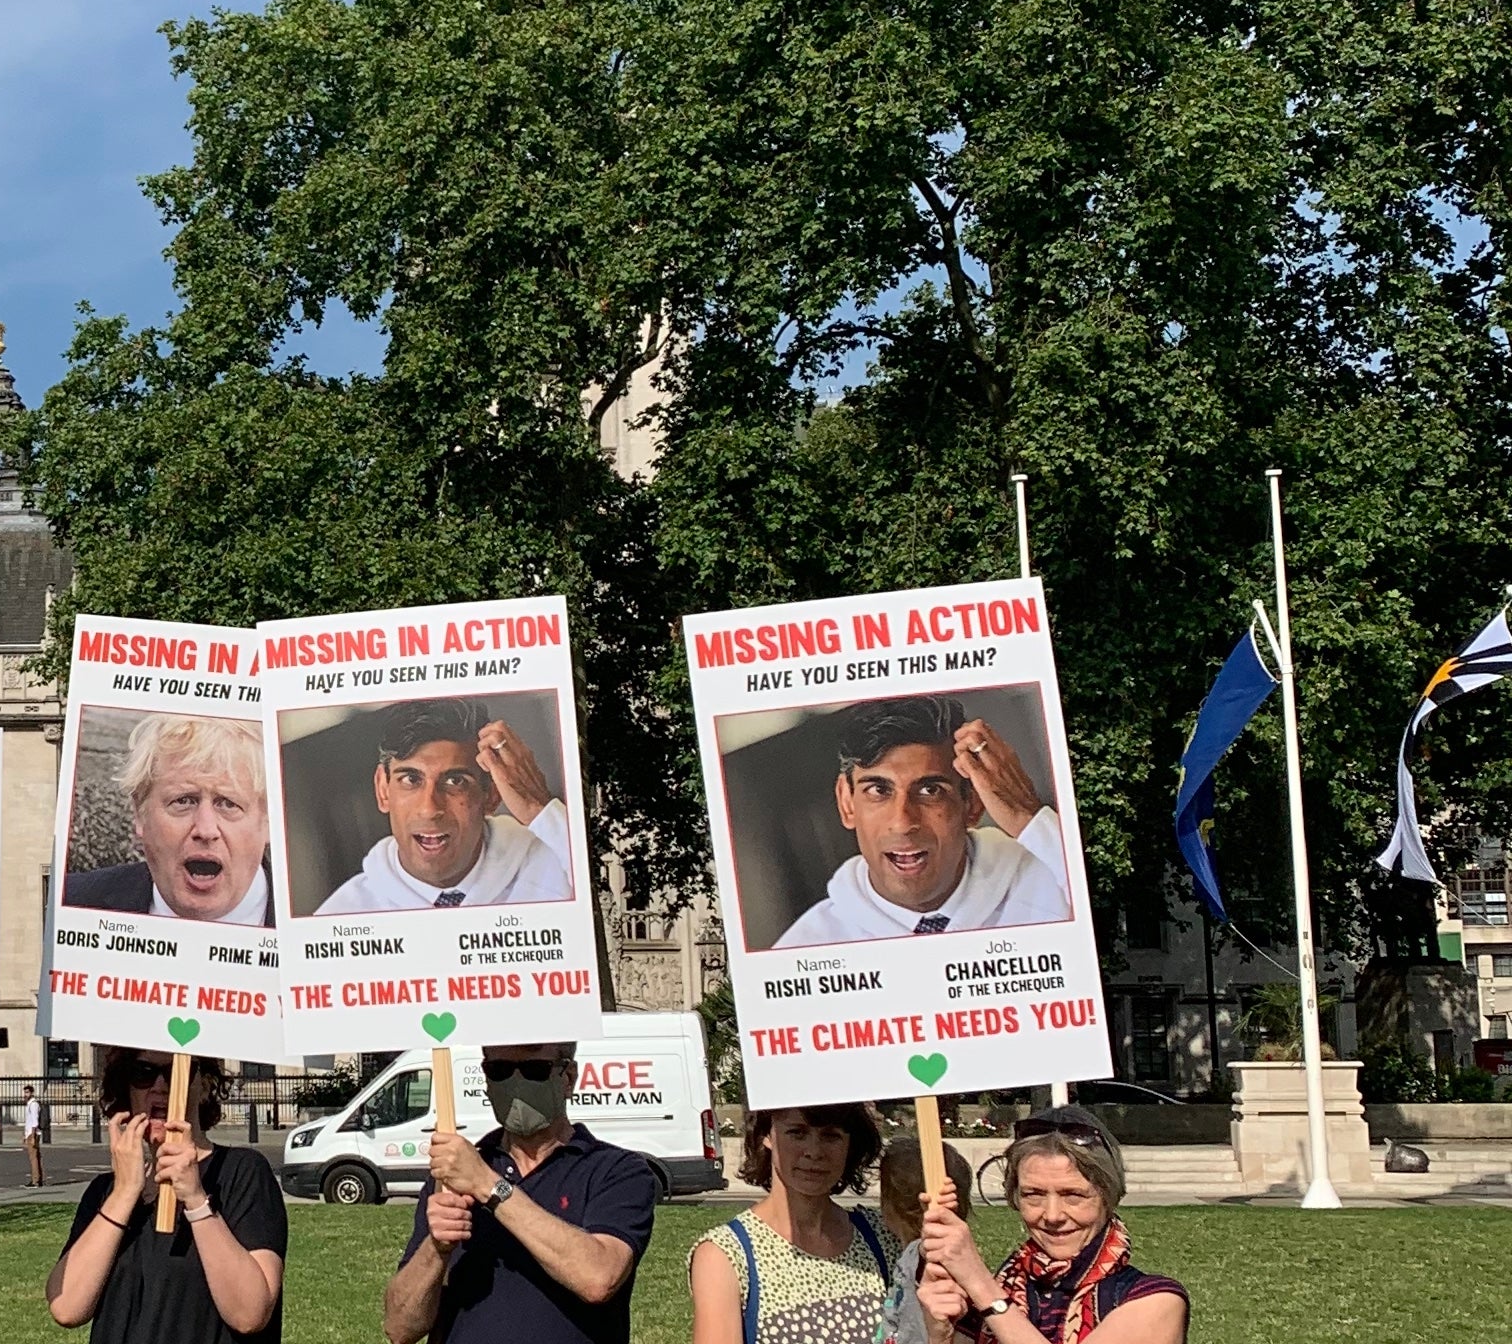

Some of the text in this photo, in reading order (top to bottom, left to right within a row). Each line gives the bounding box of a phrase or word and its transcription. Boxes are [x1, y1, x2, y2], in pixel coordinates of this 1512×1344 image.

[265, 628, 388, 670] MISSING
[398, 624, 430, 657] IN
[443, 614, 561, 654] ACTION
[694, 597, 1041, 669] MISSING IN ACTION
[78, 630, 198, 671] MISSING
[207, 642, 239, 675] IN
[305, 656, 522, 691] HAVE YOU SEEN THIS MAN?
[746, 646, 997, 693] HAVE YOU SEEN THIS MAN?
[112, 673, 262, 703] HAVE YOU SEEN THI
[98, 918, 139, 934] Name:
[332, 924, 375, 938] Name:
[494, 914, 523, 928] Job:
[56, 928, 178, 958] BORIS JOHNSON
[304, 937, 405, 960] RISHI SUNAK
[458, 928, 563, 951] CHANCELLOR
[985, 939, 1018, 955] Job:
[208, 945, 254, 966] PRIME
[460, 948, 564, 966] OF THE EXCHEQUER
[796, 958, 847, 973] Name:
[944, 953, 1063, 982] CHANCELLOR
[48, 969, 89, 997] THE
[96, 975, 189, 1008] CLIMATE
[197, 986, 267, 1017] NEEDS
[290, 984, 333, 1010] THE
[342, 978, 439, 1007] CLIMATE
[447, 973, 522, 1001] NEEDS
[531, 969, 591, 997] YOU!
[763, 970, 883, 1000] RISHI SUNAK
[947, 975, 1065, 999] OF THE EXCHEQUER
[749, 998, 1097, 1057] THE CLIMATE NEEDS YOU!
[579, 1061, 654, 1090] ACE
[570, 1091, 662, 1106] RENT A VAN
